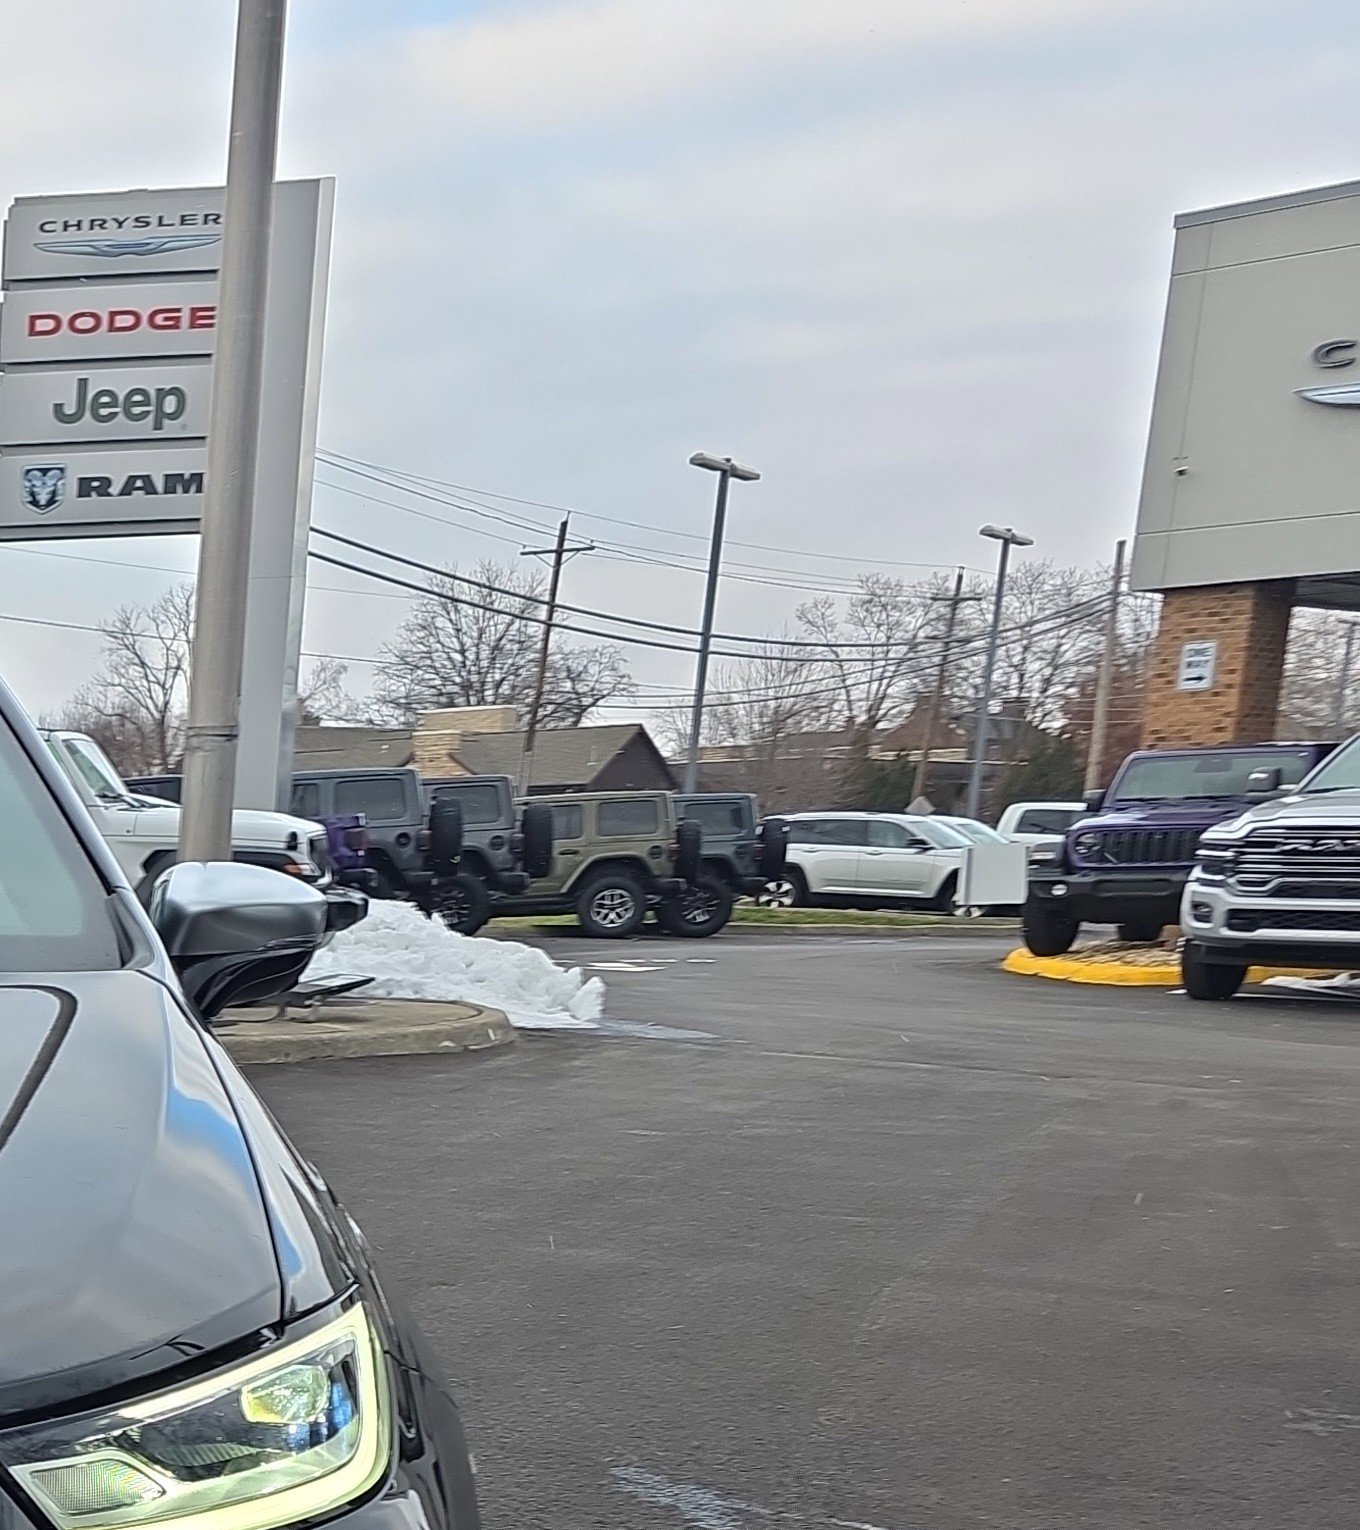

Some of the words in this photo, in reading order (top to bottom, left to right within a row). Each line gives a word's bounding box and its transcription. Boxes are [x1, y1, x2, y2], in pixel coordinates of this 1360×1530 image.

[38, 212, 223, 234] CHRYSLER
[27, 305, 218, 338] DODGE
[52, 377, 187, 431] Jeep
[75, 472, 205, 499] RAM
